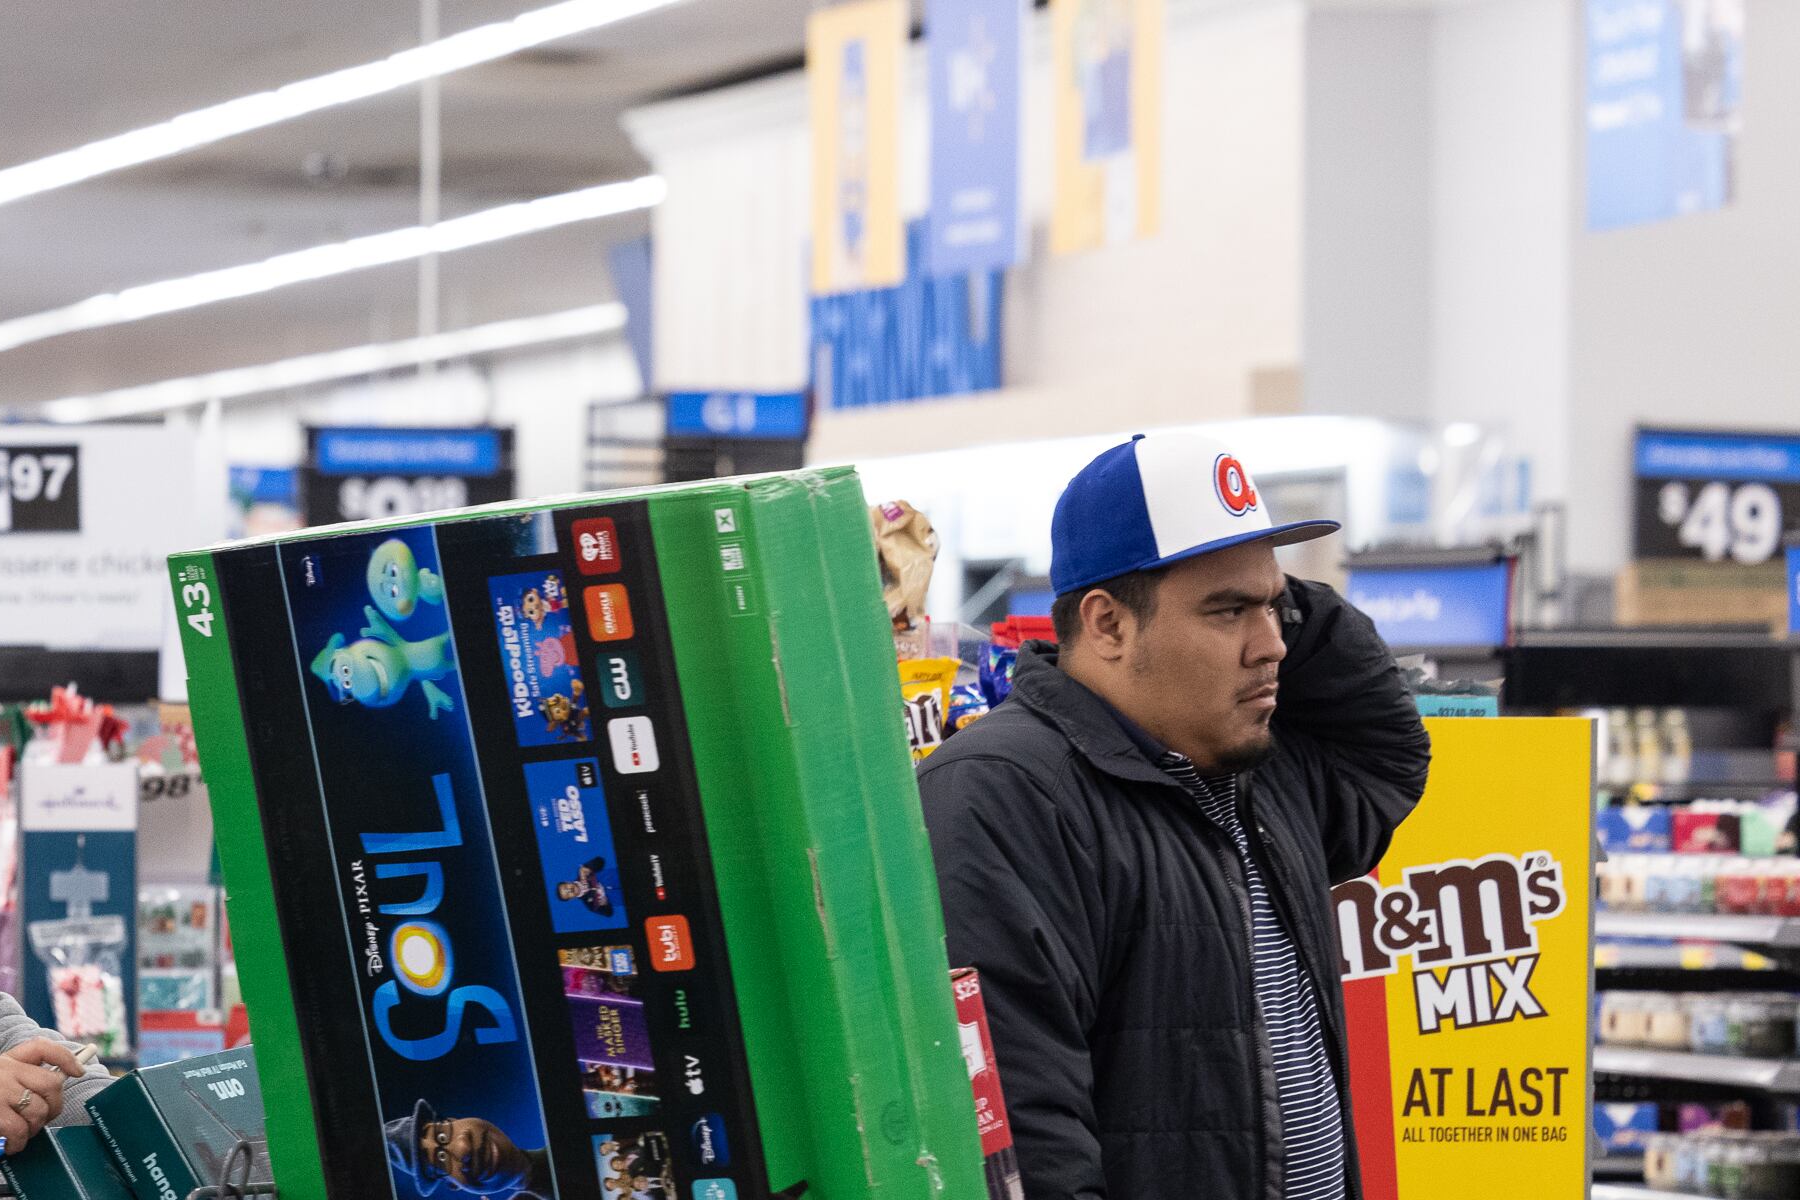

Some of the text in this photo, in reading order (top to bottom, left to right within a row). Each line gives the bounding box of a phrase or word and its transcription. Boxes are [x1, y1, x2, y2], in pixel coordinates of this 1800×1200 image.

[1657, 482, 1783, 565] $49
[99, 553, 168, 577] chicke
[352, 860, 370, 913] PIXAR
[657, 924, 677, 963] tubi
[673, 989, 692, 1029] hulu
[1413, 953, 1549, 1035] MIX
[598, 1005, 616, 1057] MASKED
[610, 1008, 627, 1054] SINGER
[1402, 1067, 1569, 1117] AT LAST
[94, 1116, 112, 1141] Motion
[120, 1161, 138, 1185] Mount
[1402, 1126, 1567, 1143] ALL TOGETHER IN ONE BAG
